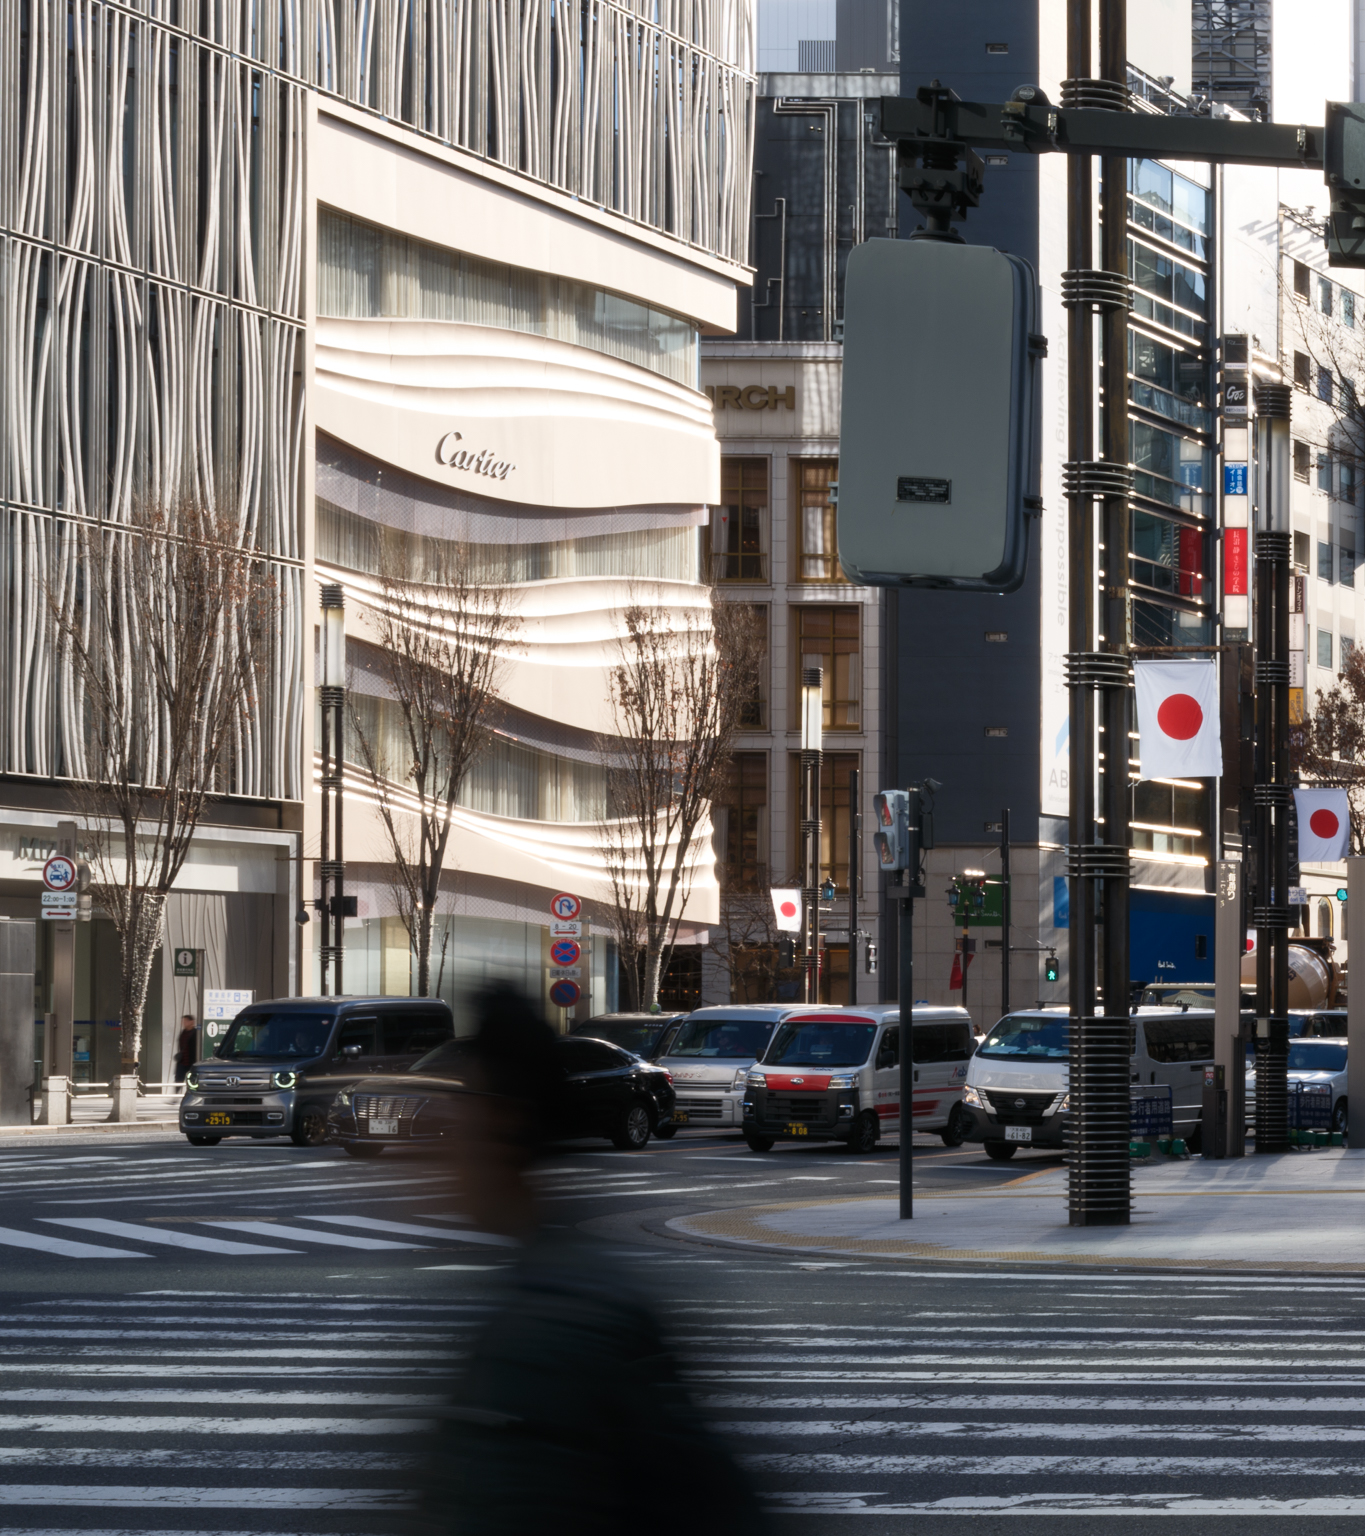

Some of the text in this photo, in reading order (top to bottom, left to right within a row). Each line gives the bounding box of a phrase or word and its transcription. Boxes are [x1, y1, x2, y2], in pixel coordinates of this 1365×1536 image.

[435, 430, 518, 481] Cartier
[209, 1116, 231, 1125] 29-19
[1010, 1132, 1031, 1140] 61-82
